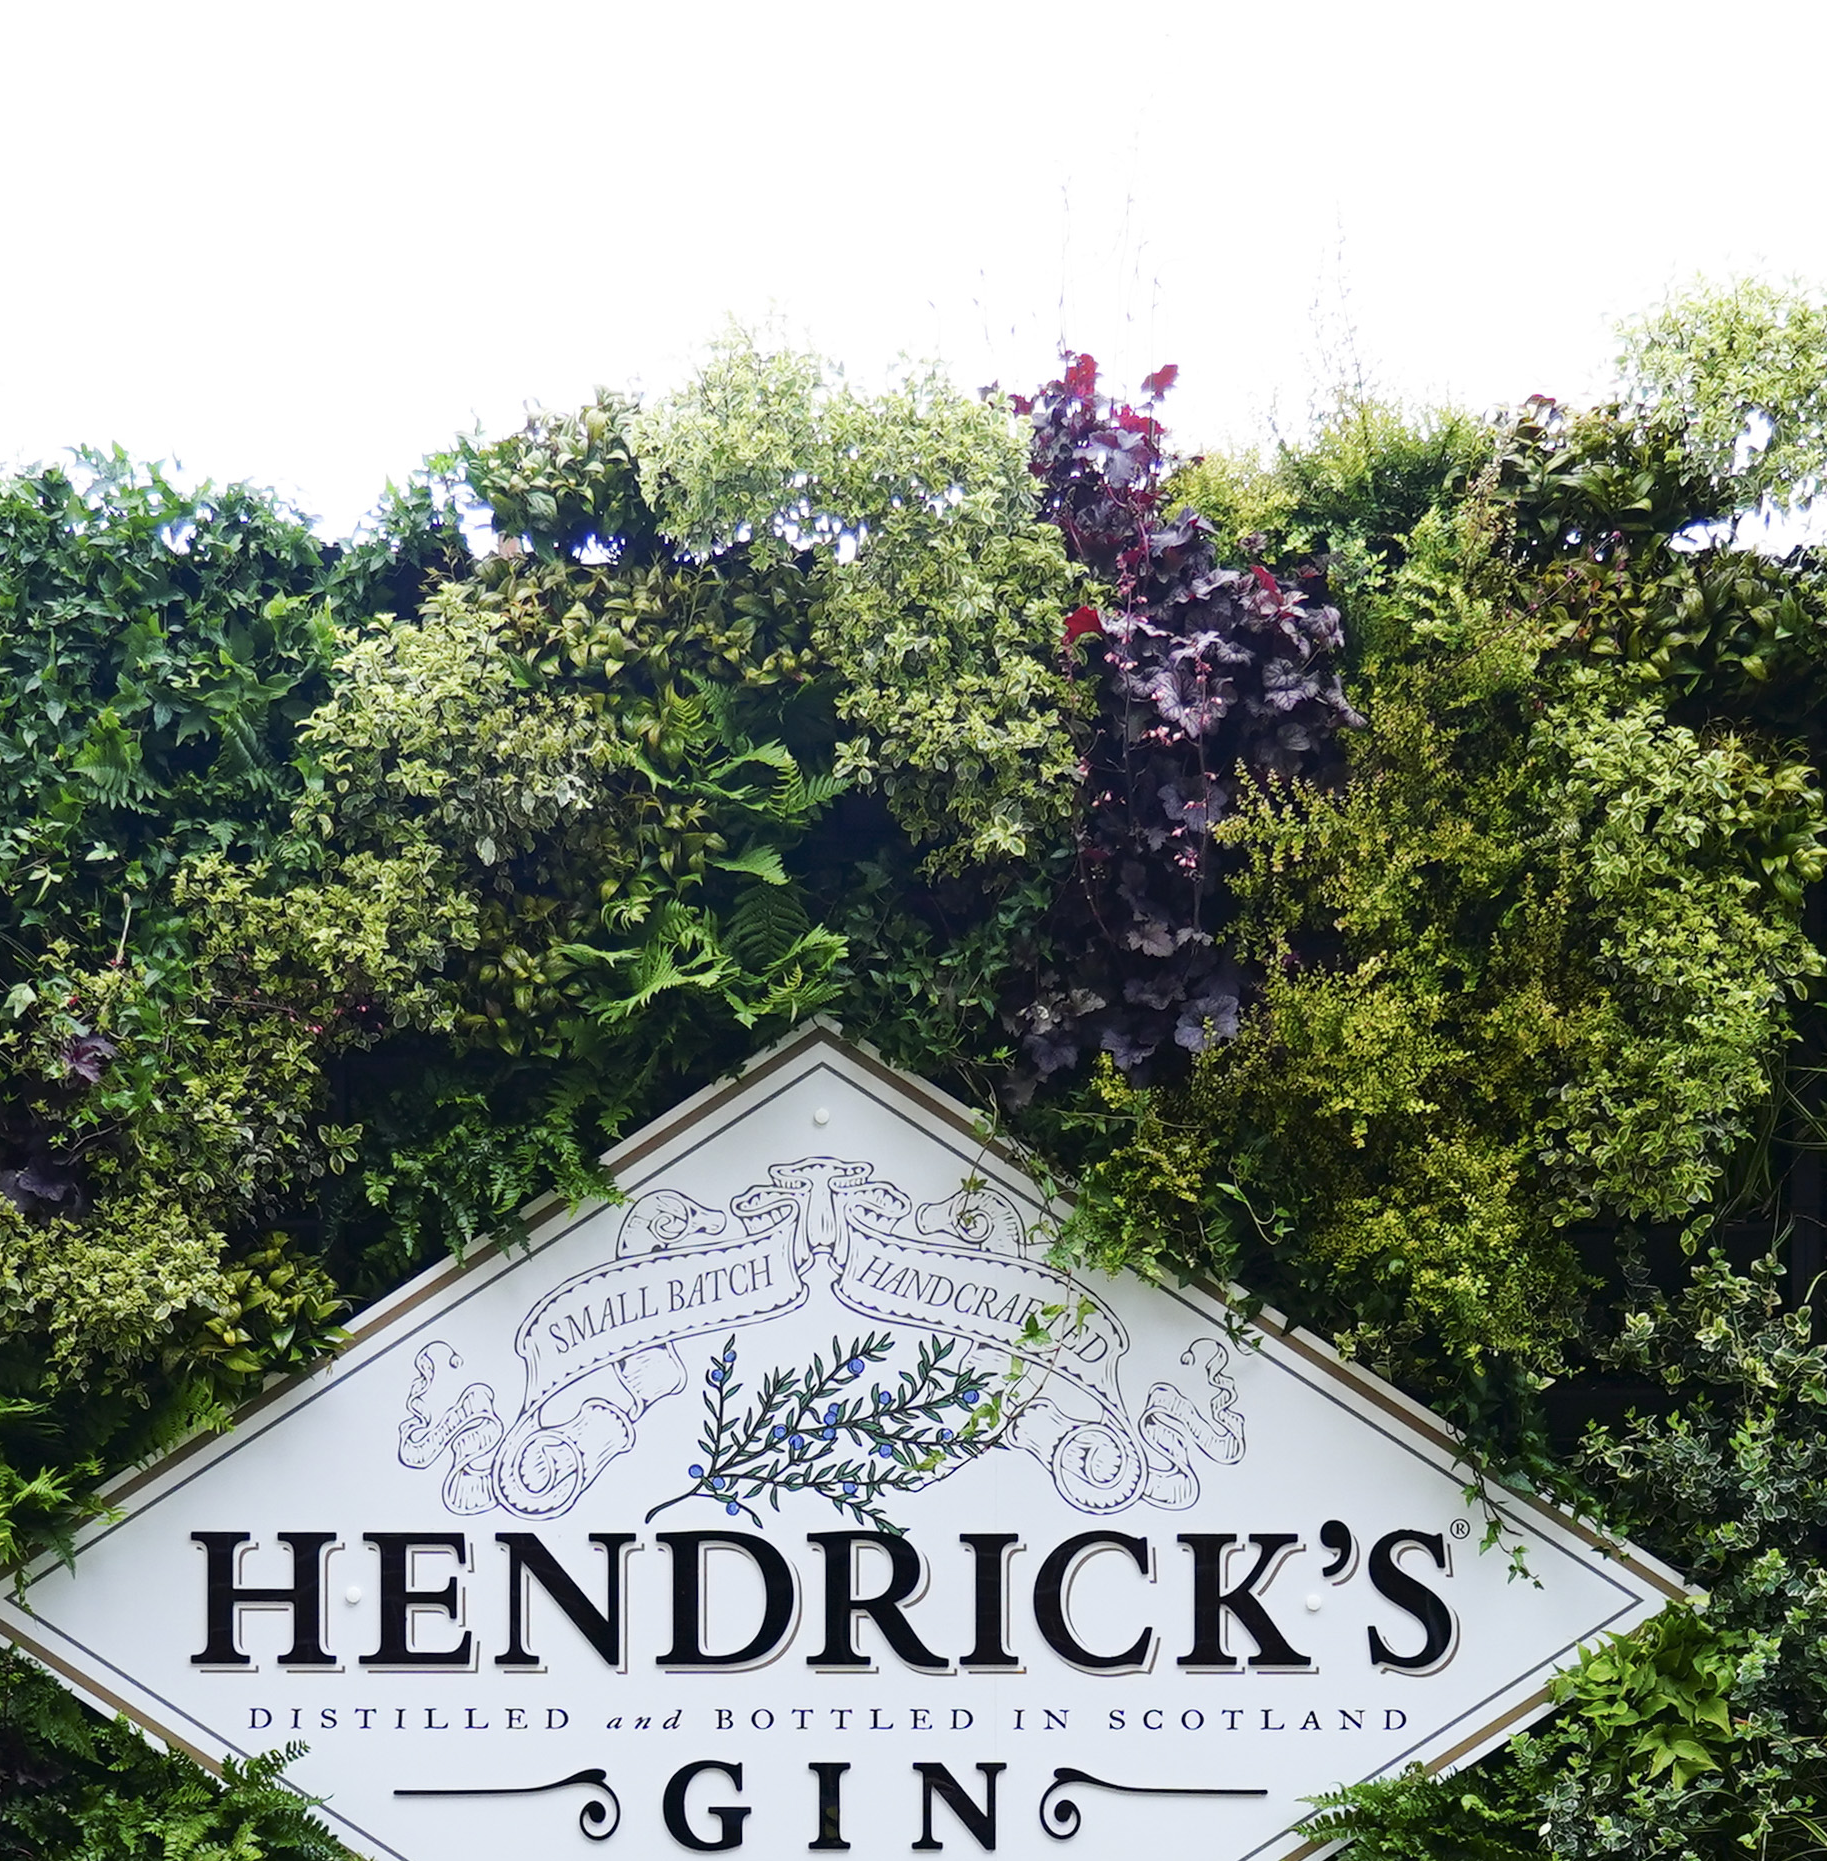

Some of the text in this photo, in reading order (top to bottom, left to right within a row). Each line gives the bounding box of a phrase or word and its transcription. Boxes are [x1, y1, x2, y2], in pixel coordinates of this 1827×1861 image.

[548, 1254, 774, 1354] SMALL BATCH
[247, 1707, 1409, 1731] DISTILLED and BOTTLED IN SCOTLAND
[662, 1759, 1008, 1852] GIN
